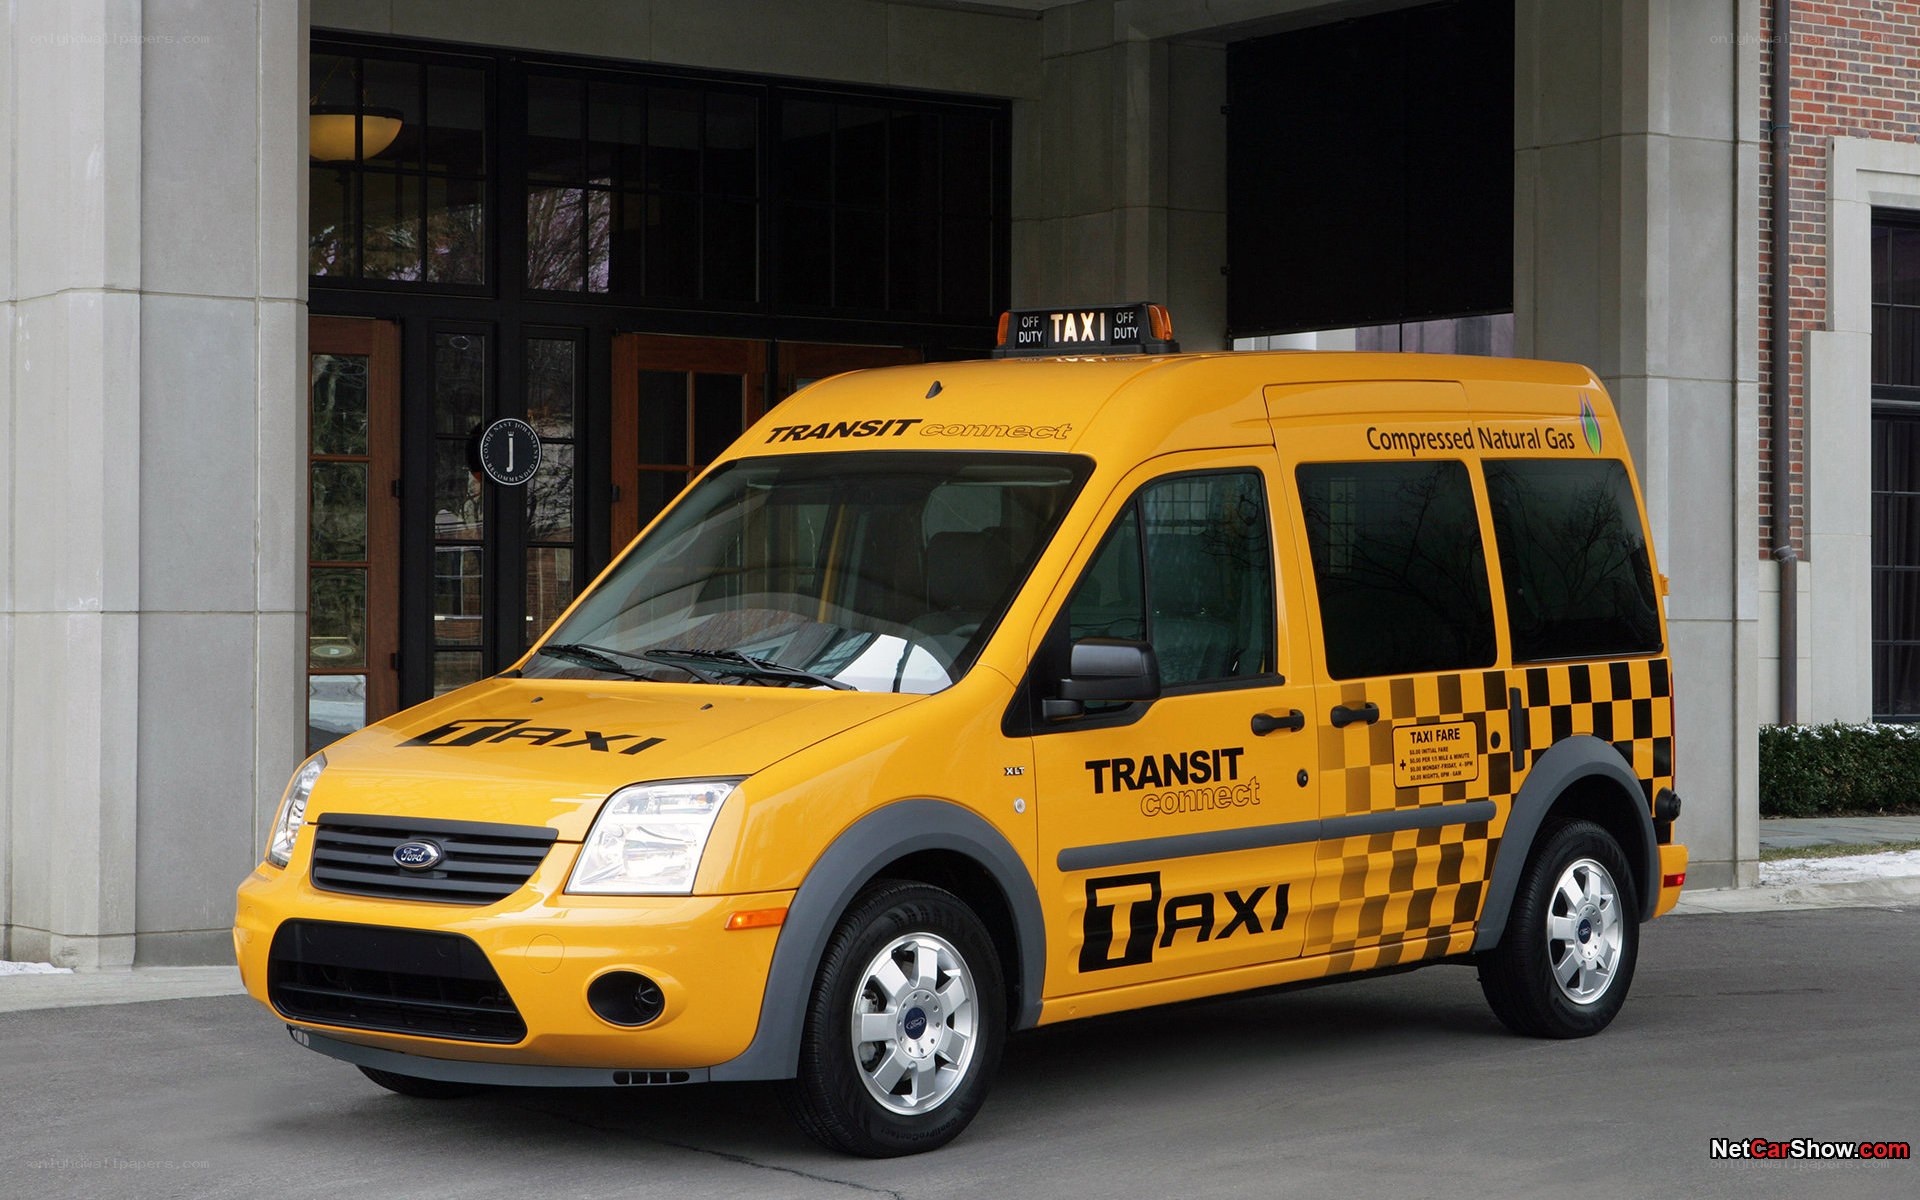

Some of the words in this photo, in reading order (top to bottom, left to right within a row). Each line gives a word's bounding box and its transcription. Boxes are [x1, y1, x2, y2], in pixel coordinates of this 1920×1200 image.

[1022, 315, 1040, 328] OFF
[1050, 312, 1105, 342] TAXI
[1115, 311, 1134, 324] OFF
[1018, 330, 1043, 343] DUTY
[1113, 327, 1139, 340] DUTY
[764, 418, 923, 444] TRANSIT
[919, 422, 1073, 440] connect
[1366, 426, 1475, 457] Compressed
[1477, 427, 1541, 450] Natural
[1545, 427, 1575, 450] Gas
[394, 718, 667, 755] TAXI
[1410, 730, 1433, 744] TAXI
[1436, 728, 1460, 742] FARE
[1004, 766, 1024, 776] XLT
[1085, 747, 1244, 794] TRANSIT
[1140, 776, 1260, 817] connect
[400, 847, 425, 862] Ford
[1078, 870, 1290, 973] TAXI
